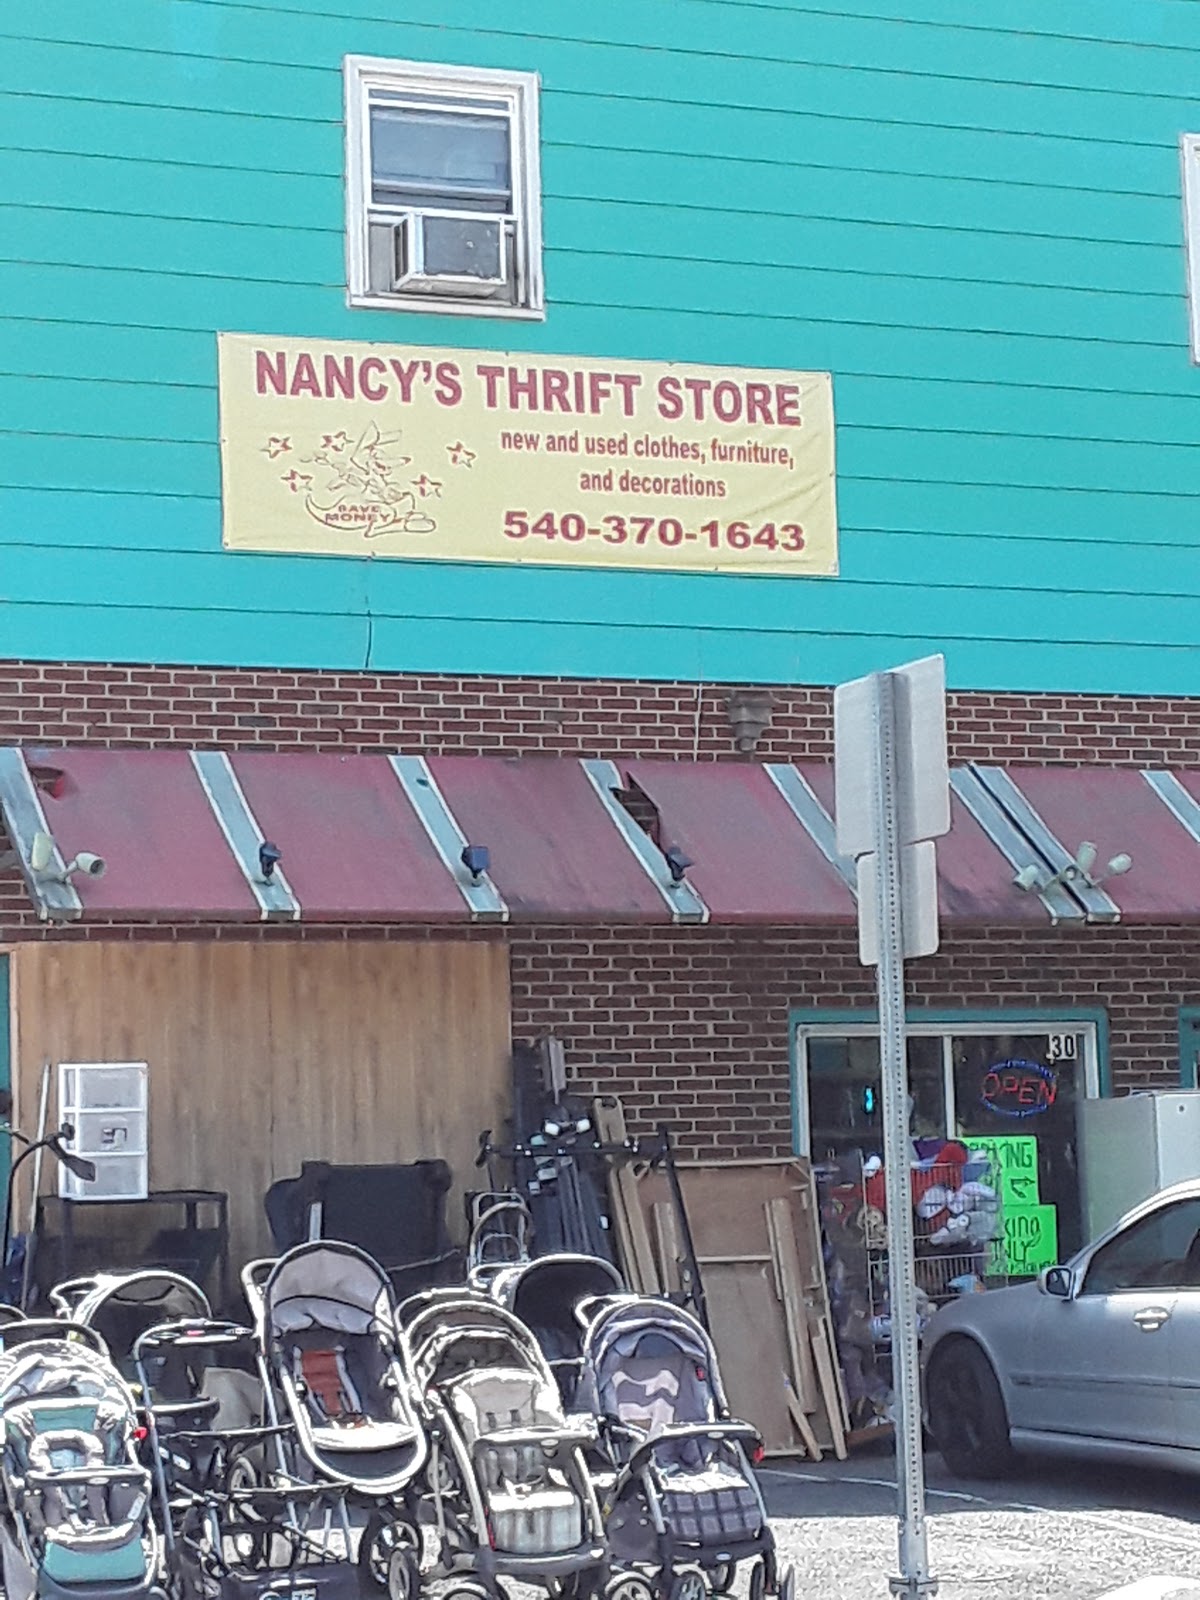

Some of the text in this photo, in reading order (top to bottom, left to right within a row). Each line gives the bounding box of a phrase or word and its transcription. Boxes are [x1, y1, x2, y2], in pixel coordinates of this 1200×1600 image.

[256, 350, 801, 427] NANCY'S THRIFT STORE
[501, 430, 794, 469] new and used clothes, furniture,
[580, 468, 727, 497] and decorations
[325, 513, 390, 522] MONEY
[503, 510, 806, 551] 540-370-1643
[1050, 1035, 1075, 1058] 30
[982, 1072, 1057, 1105] OPEN
